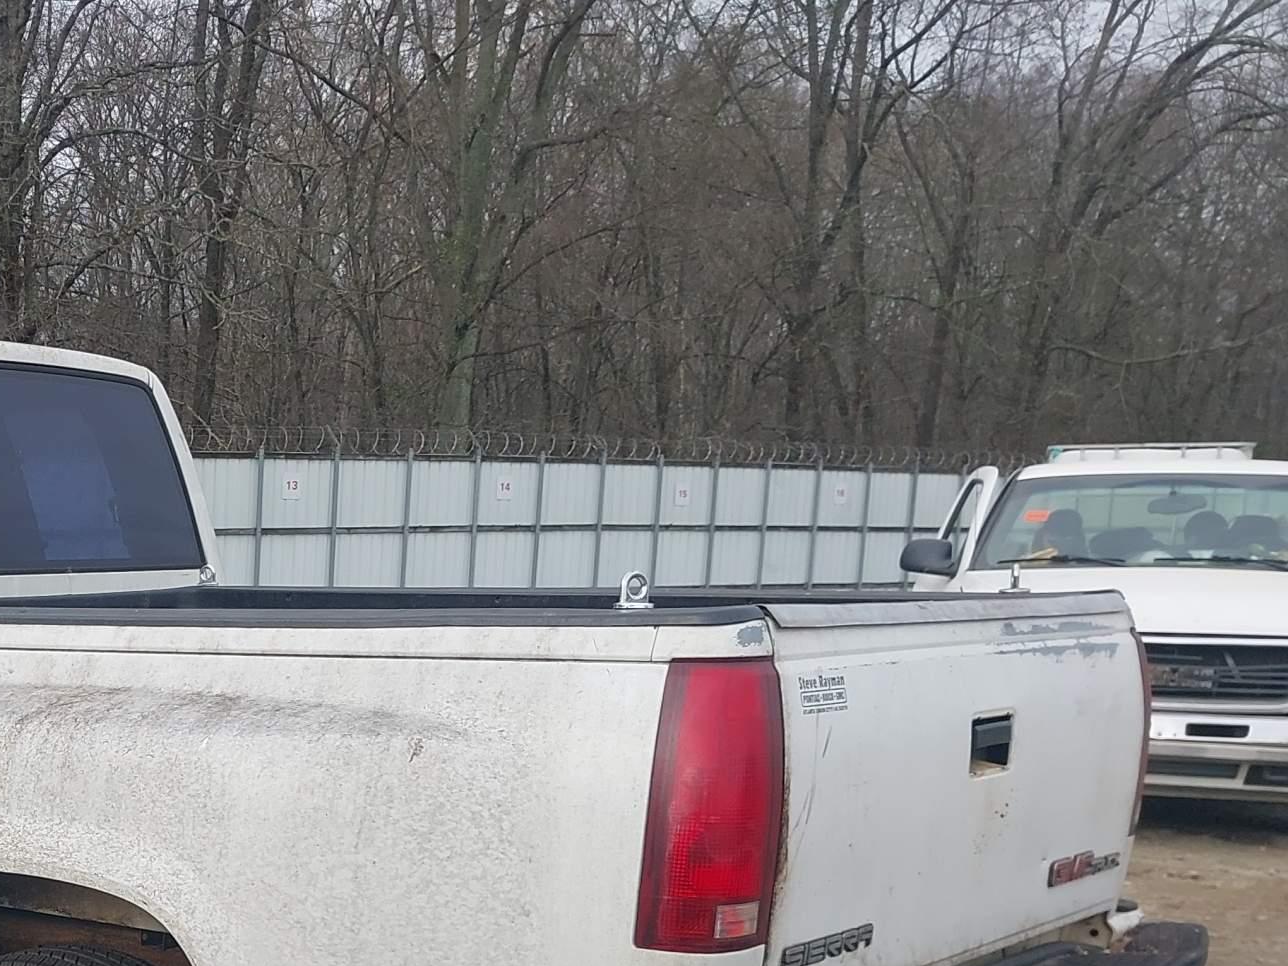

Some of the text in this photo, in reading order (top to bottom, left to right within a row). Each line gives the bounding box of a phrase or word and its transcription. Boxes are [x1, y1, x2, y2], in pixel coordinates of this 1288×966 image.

[286, 480, 298, 490] 13
[500, 482, 511, 492] 14
[678, 489, 688, 498] 15
[798, 675, 845, 690] Steve Rayman
